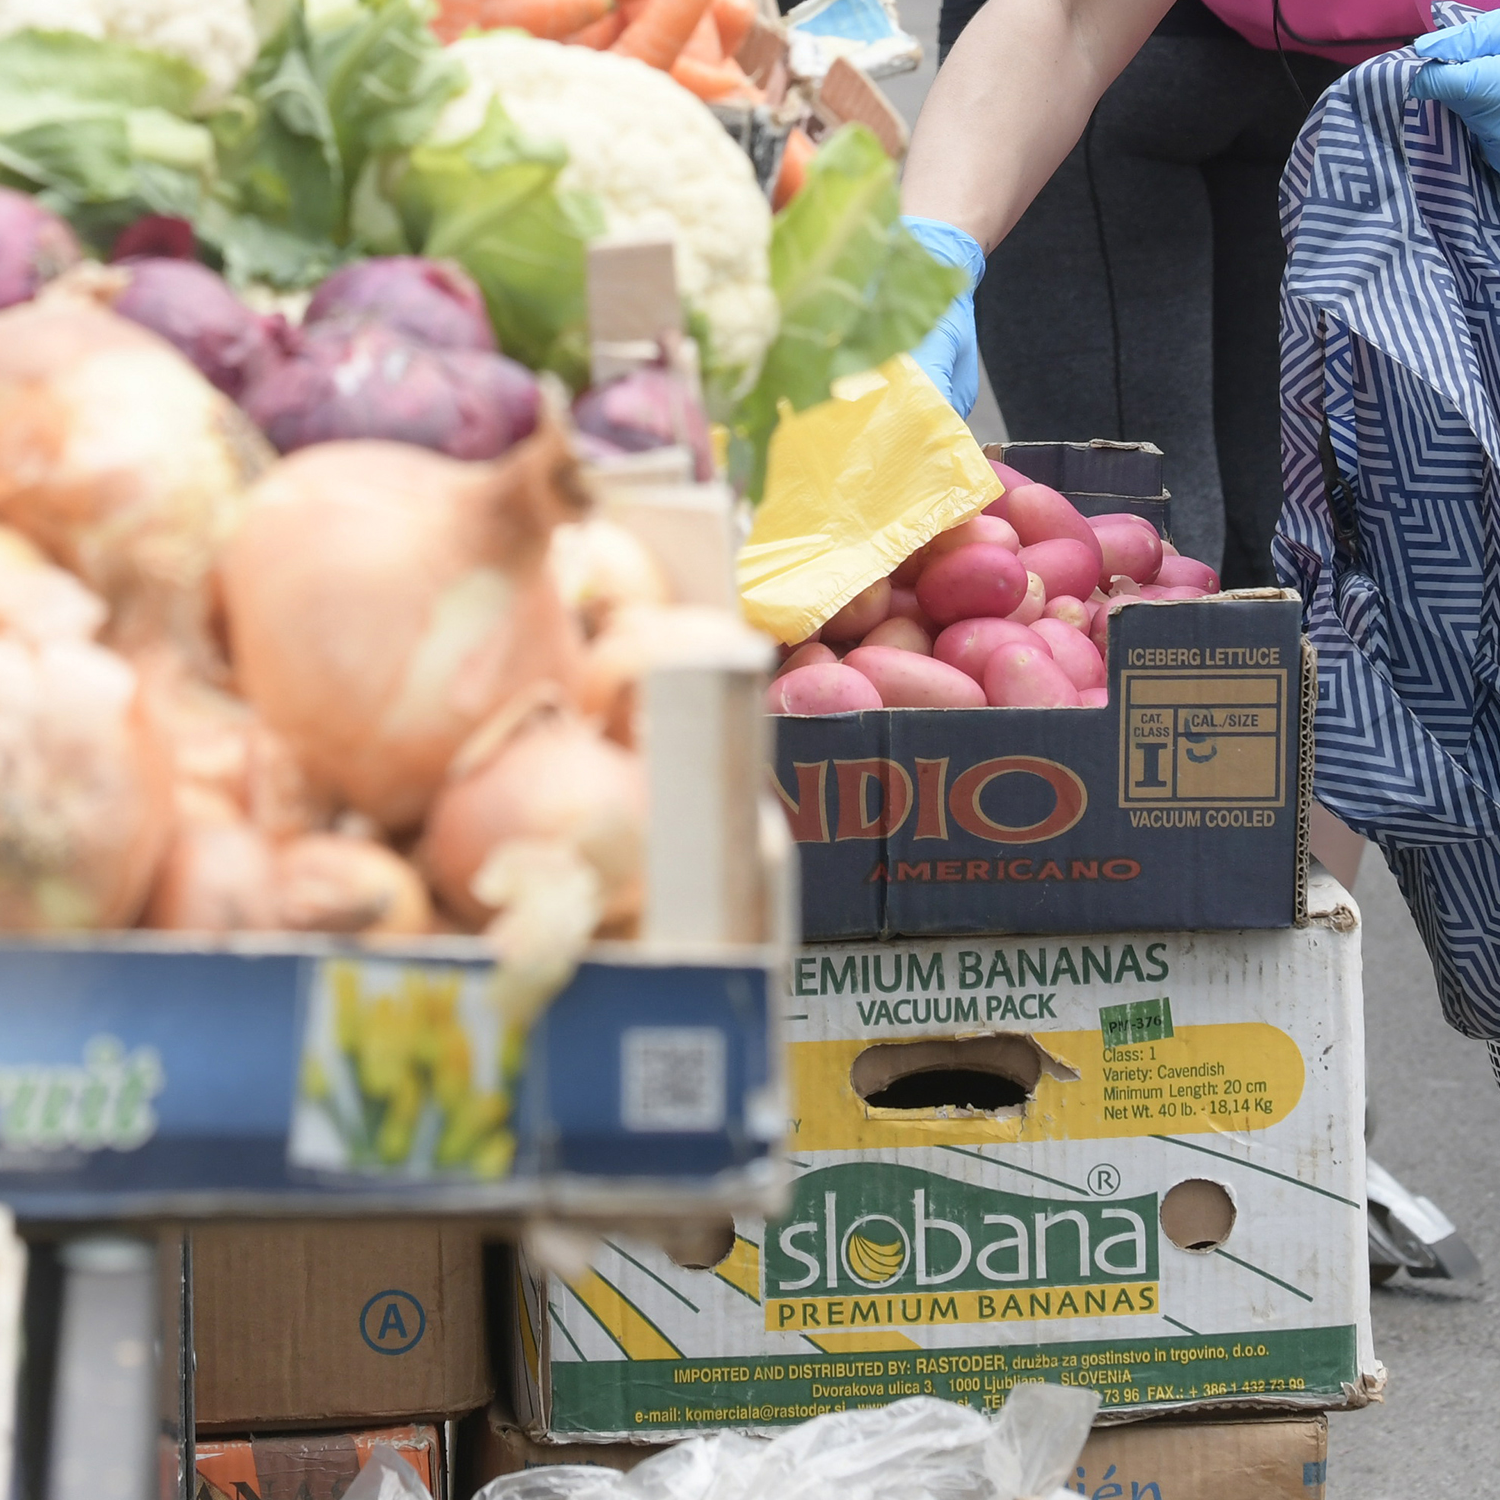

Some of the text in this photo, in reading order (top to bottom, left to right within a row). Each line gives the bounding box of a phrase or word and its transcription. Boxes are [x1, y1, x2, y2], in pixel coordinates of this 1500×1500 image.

[1128, 647, 1280, 666] ICEBERG LETTUCE
[1140, 713, 1163, 725] CAT.
[1191, 714, 1259, 728] CAL./SIZE
[1134, 726, 1170, 738] CLASS
[768, 755, 1088, 845] NDIO
[1130, 810, 1276, 828] VACUUM COOLED
[868, 858, 1142, 882] AMERICANO
[786, 942, 1170, 997] EMIUM BANANAS
[856, 993, 1057, 1026] VACUUM PACK
[1102, 1046, 1156, 1063] Class: 1
[1102, 1062, 1225, 1083] Variety: Cavendish
[1104, 1080, 1267, 1102] Minimum Length: 20 cm
[1104, 1105, 1128, 1121] Net
[1132, 1104, 1154, 1119] Wt.
[1158, 1103, 1177, 1117] 40
[1181, 1102, 1196, 1116] lb.
[1210, 1099, 1250, 1116] 18,14
[1255, 1097, 1273, 1115] Kg
[778, 1188, 1147, 1291] slobana
[778, 1286, 1154, 1328] PREMIUM BANANAS
[673, 1343, 1269, 1384] IMPORTED AND DISTRIBUTED BY: RASTODER, družba za gostinstvo in trgovino, d.o.o.
[812, 1381, 884, 1398] Dvorakova
[887, 1380, 920, 1395] ulica
[924, 1379, 936, 1395] 3,
[948, 1377, 981, 1392] 1000
[1061, 1369, 1132, 1386] SLOVENIA
[634, 1406, 681, 1423] e-mail:
[685, 1400, 846, 1422] komerciala@rastodersi
[1104, 1389, 1120, 1403] 73
[1123, 1388, 1140, 1403] 96
[1147, 1385, 1184, 1400] FAX.:
[1203, 1382, 1227, 1396] 386
[1230, 1381, 1237, 1393] 1
[1241, 1380, 1265, 1393] 432
[1269, 1379, 1285, 1391] 73
